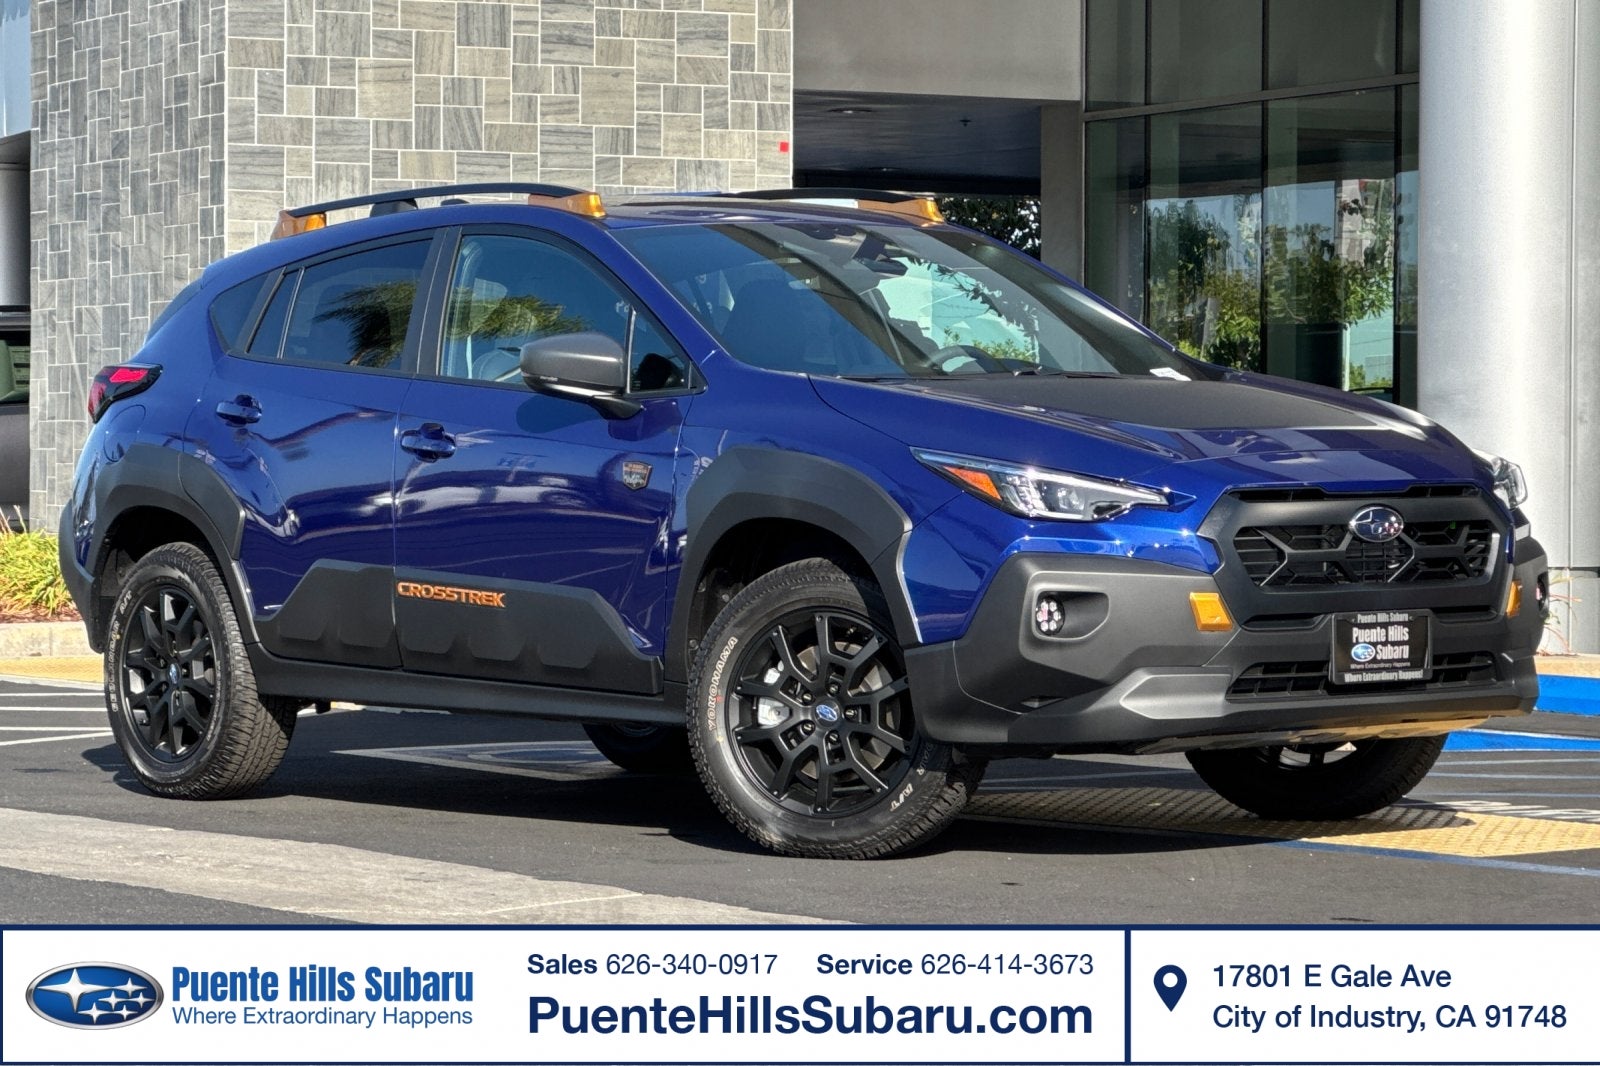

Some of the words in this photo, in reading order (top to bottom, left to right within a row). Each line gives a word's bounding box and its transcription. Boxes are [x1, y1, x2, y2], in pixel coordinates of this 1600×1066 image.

[397, 581, 507, 608] CROSSTREK
[1352, 626, 1386, 643] Puente
[1387, 624, 1409, 641] Hills
[1376, 643, 1409, 660] Subaru
[705, 636, 738, 731] YOKOHAMA
[1344, 672, 1362, 683] Where
[1363, 671, 1398, 682] Extraordinary
